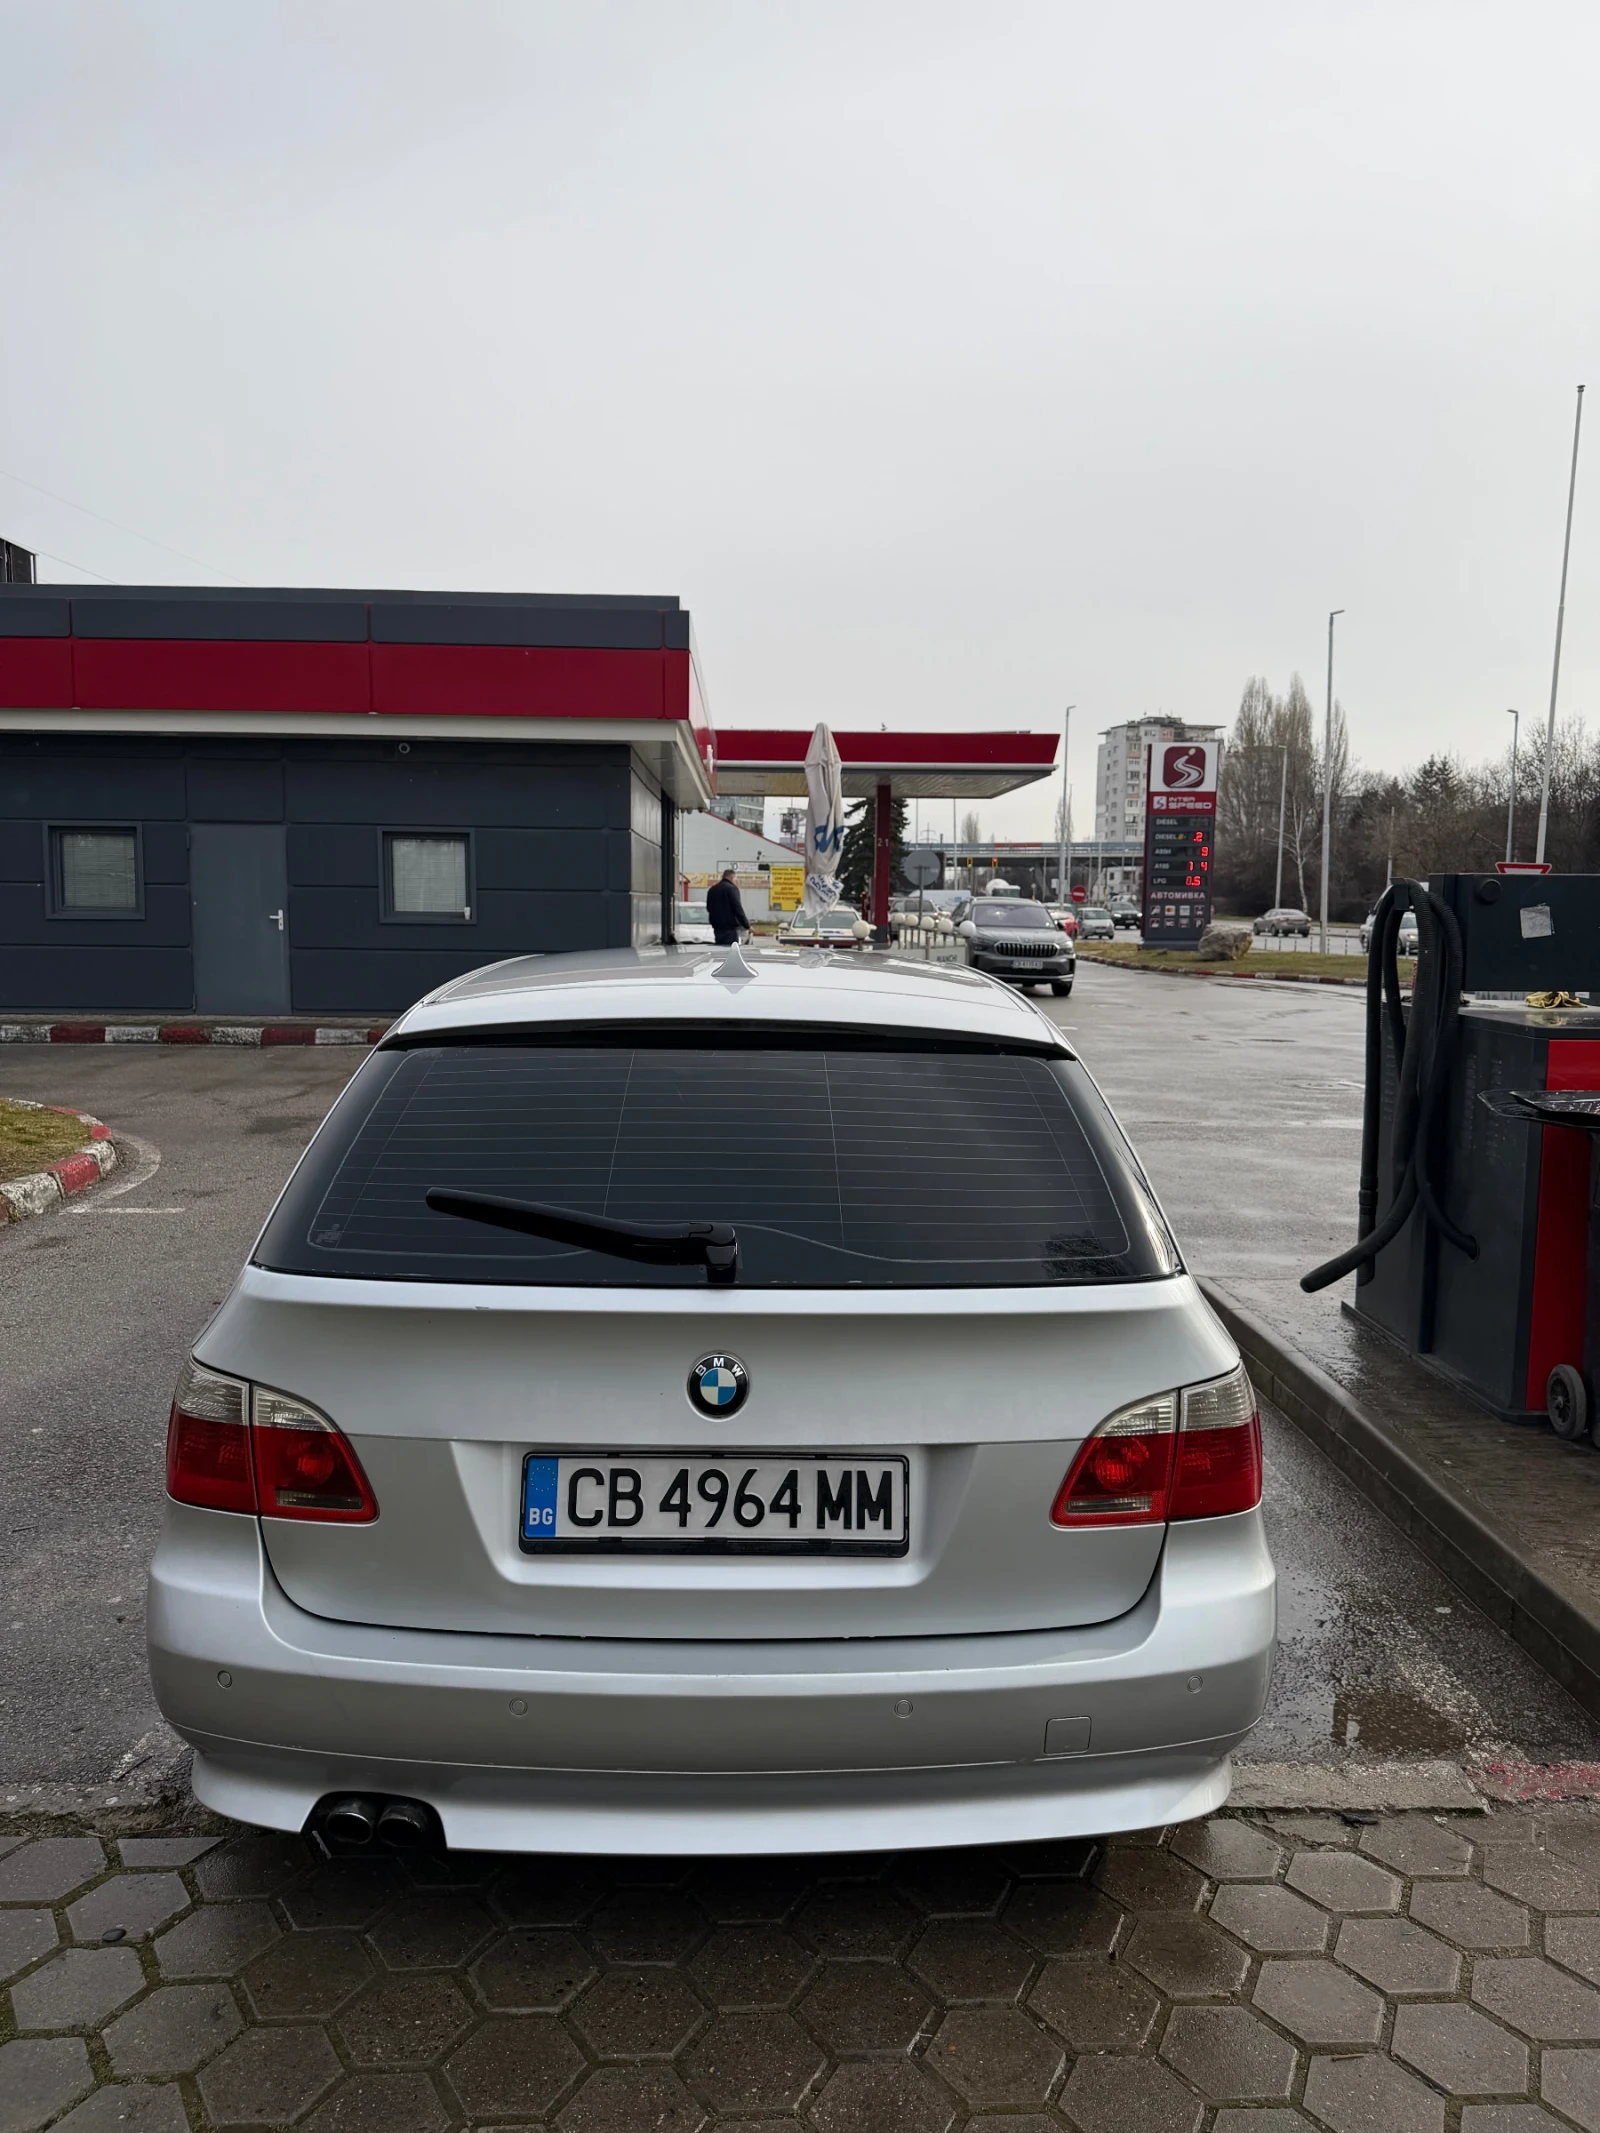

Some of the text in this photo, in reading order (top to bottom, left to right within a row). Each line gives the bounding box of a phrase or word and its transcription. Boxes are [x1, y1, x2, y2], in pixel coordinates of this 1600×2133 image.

[1168, 802, 1212, 810] SPEED
[1150, 891, 1205, 899] АВТОМИВКА
[695, 1357, 743, 1377] BMW
[567, 1467, 893, 1530] CB 4964 MM
[529, 1508, 553, 1526] BG
